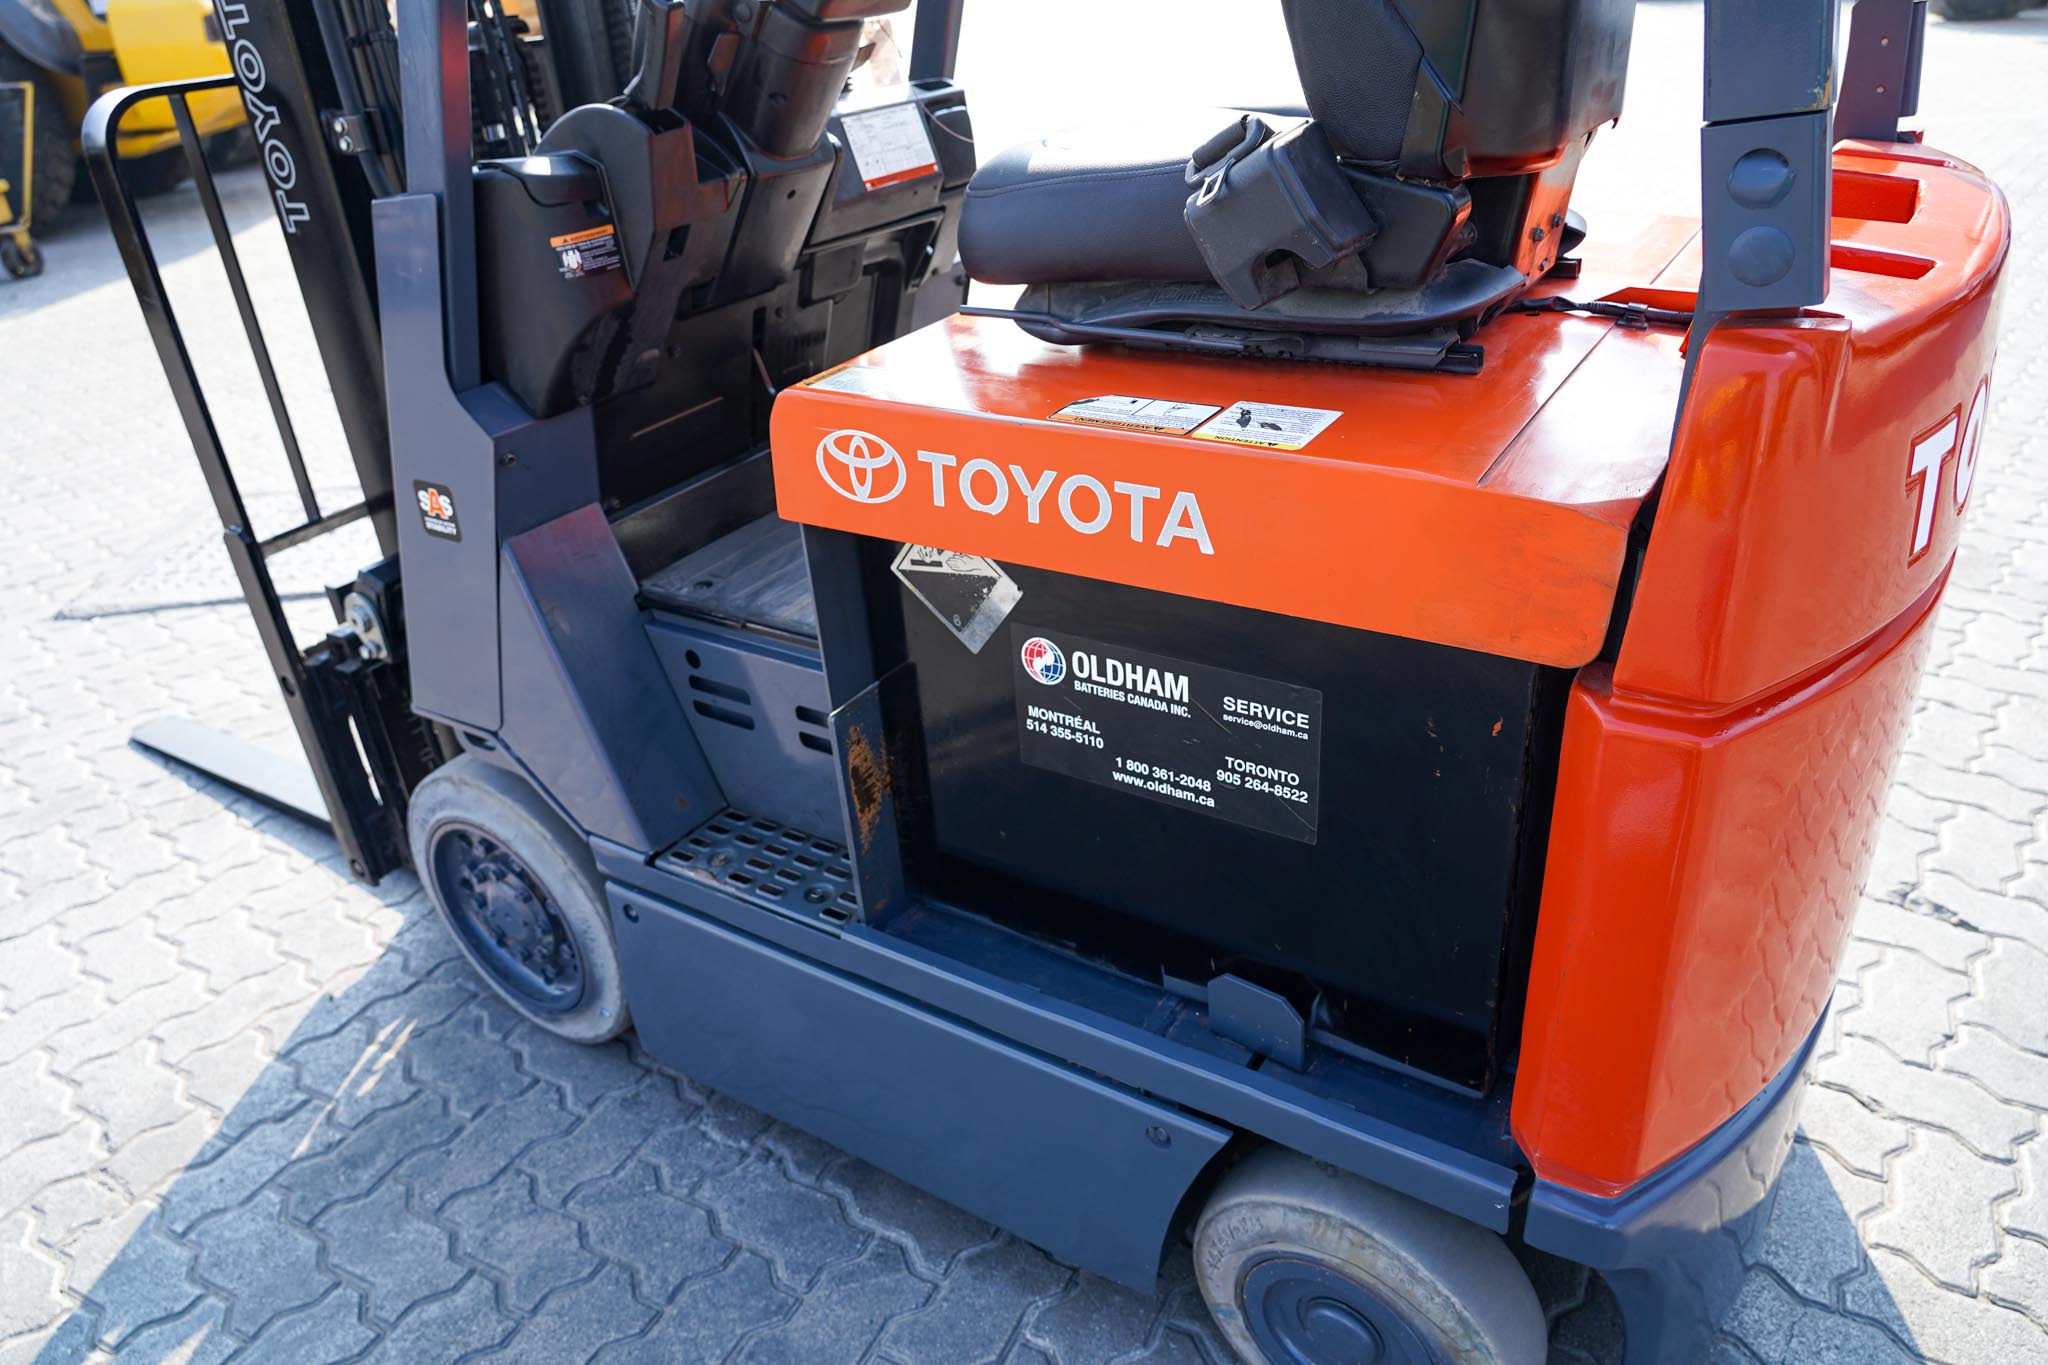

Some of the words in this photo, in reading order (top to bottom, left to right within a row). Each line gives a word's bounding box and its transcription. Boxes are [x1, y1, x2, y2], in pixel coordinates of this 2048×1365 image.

[1074, 416, 1153, 430] AVERTISSEMENT
[1214, 435, 1267, 446] ATTENTION
[417, 487, 454, 521] SAS
[916, 449, 1215, 555] TOYOTA
[1071, 650, 1190, 703] OLDHAM
[1074, 680, 1125, 703] BATTERIES
[1127, 693, 1169, 713] CANADA
[1170, 704, 1191, 718] INC.
[1223, 696, 1310, 729] SERVICE
[1026, 718, 1050, 734] 514
[1050, 725, 1104, 750] 355-5110
[1028, 705, 1101, 735] MONTRÉAL
[1222, 713, 1309, 740] service@oldham.ca
[1115, 757, 1122, 768] 1
[1126, 759, 1150, 776] 800
[1152, 766, 1212, 793] 361-2048
[1216, 769, 1242, 786] 905
[1244, 778, 1309, 804] 264-8522
[1225, 756, 1300, 787] TORONTO
[1112, 770, 1216, 809] www.oldham.ca
